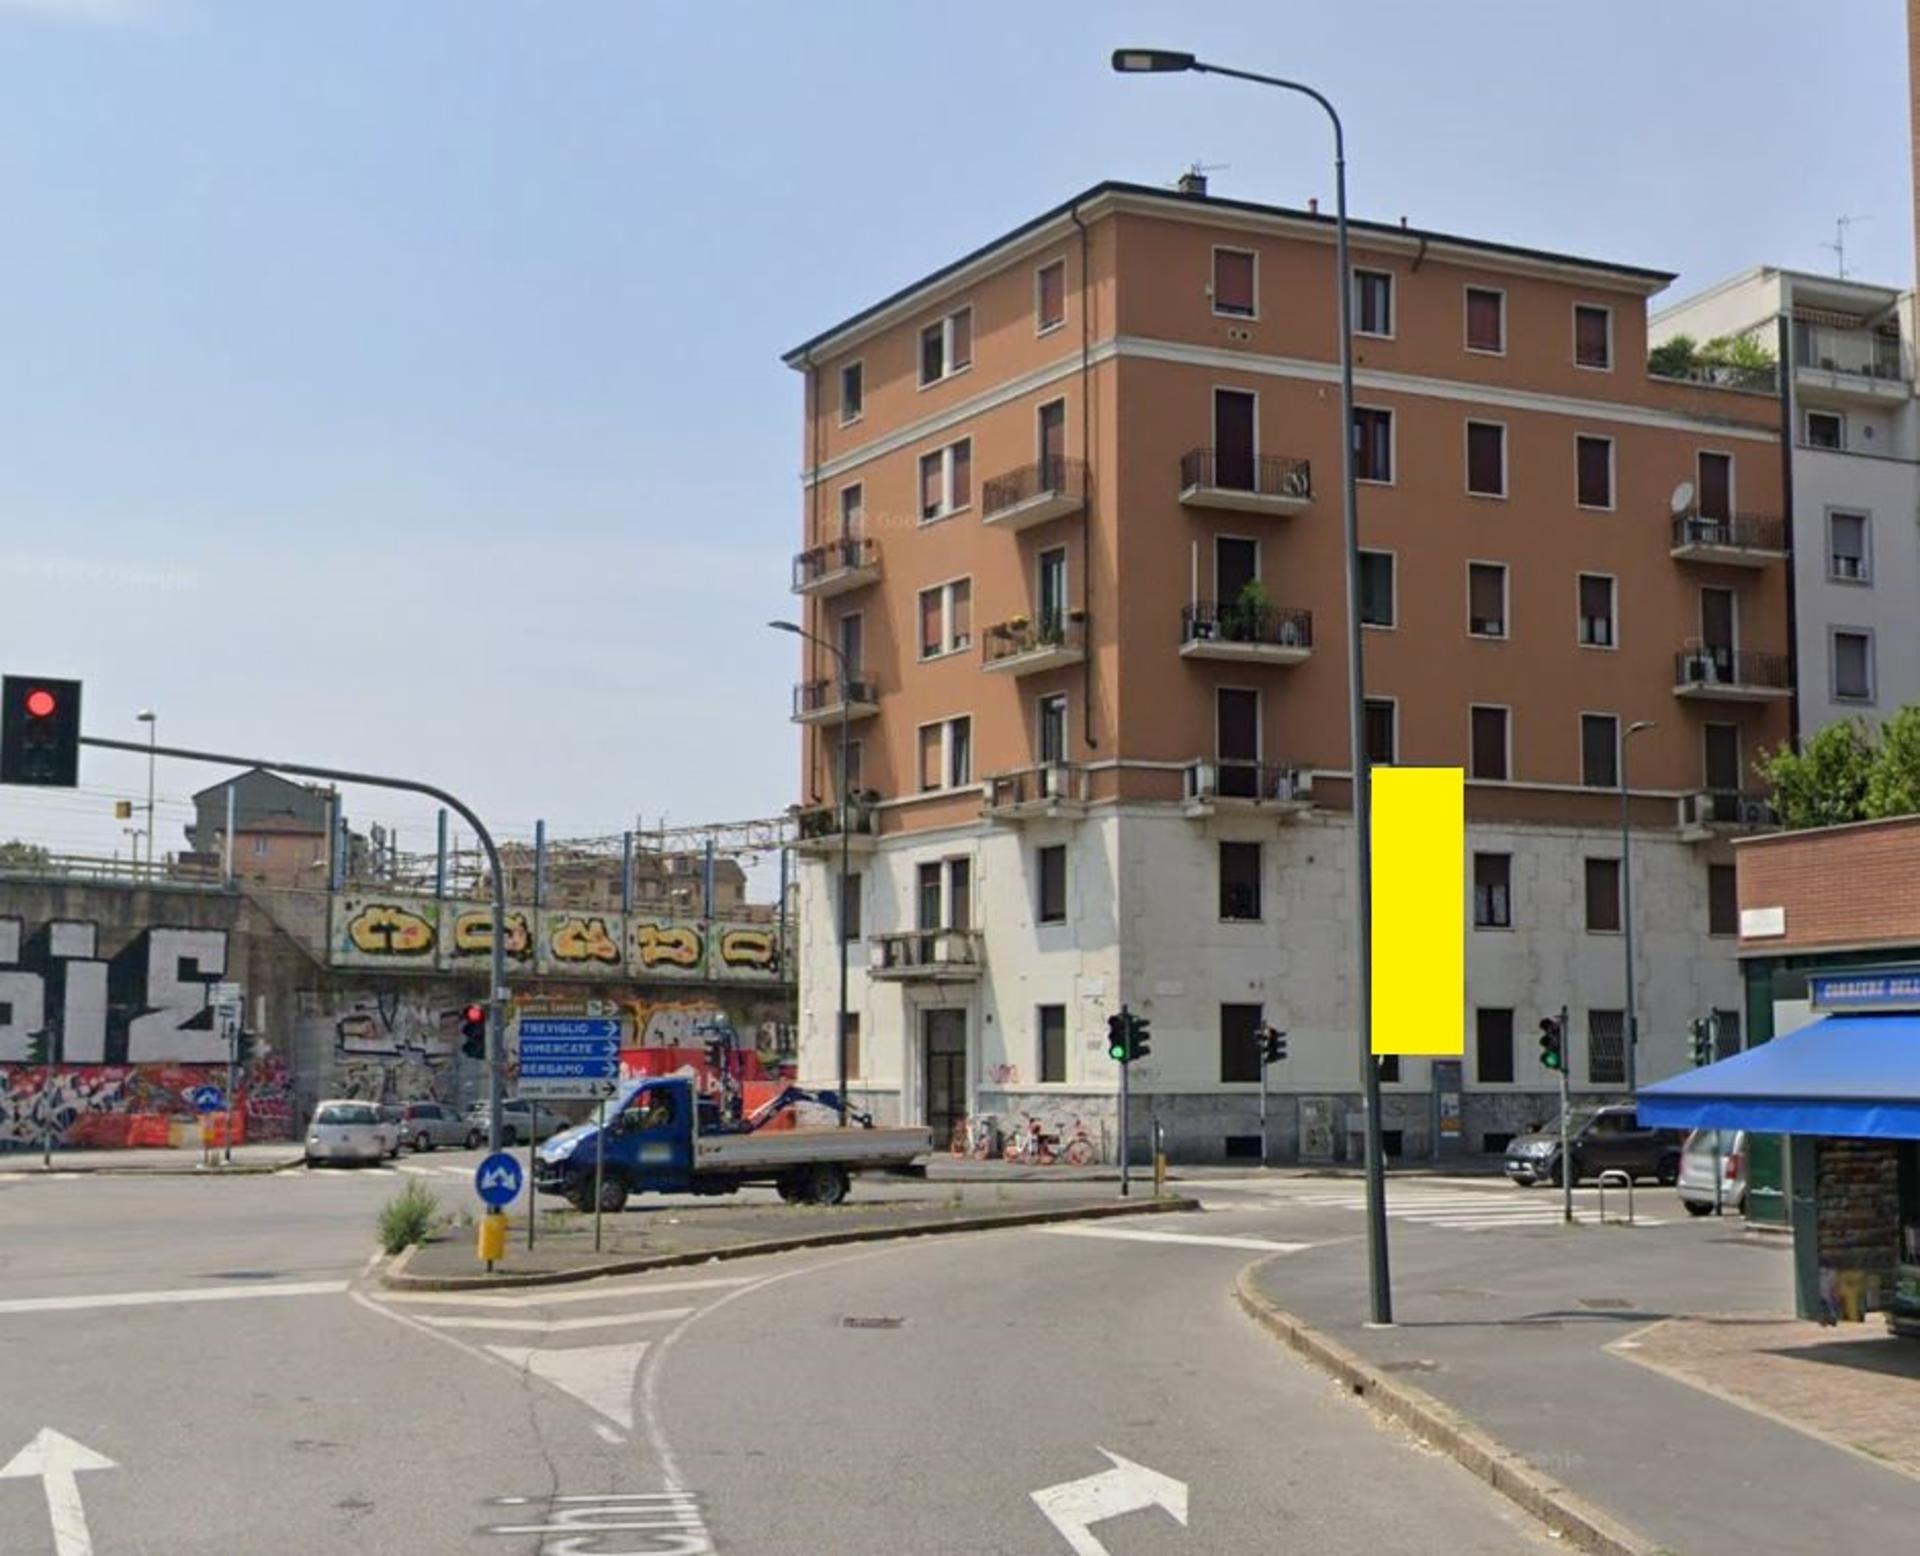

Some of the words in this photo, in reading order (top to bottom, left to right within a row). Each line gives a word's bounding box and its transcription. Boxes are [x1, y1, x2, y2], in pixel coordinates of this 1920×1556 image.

[522, 1022, 590, 1034] TREVIGLIO
[522, 1042, 593, 1054] VIMERCATE
[522, 1063, 585, 1075] BERGAMO
